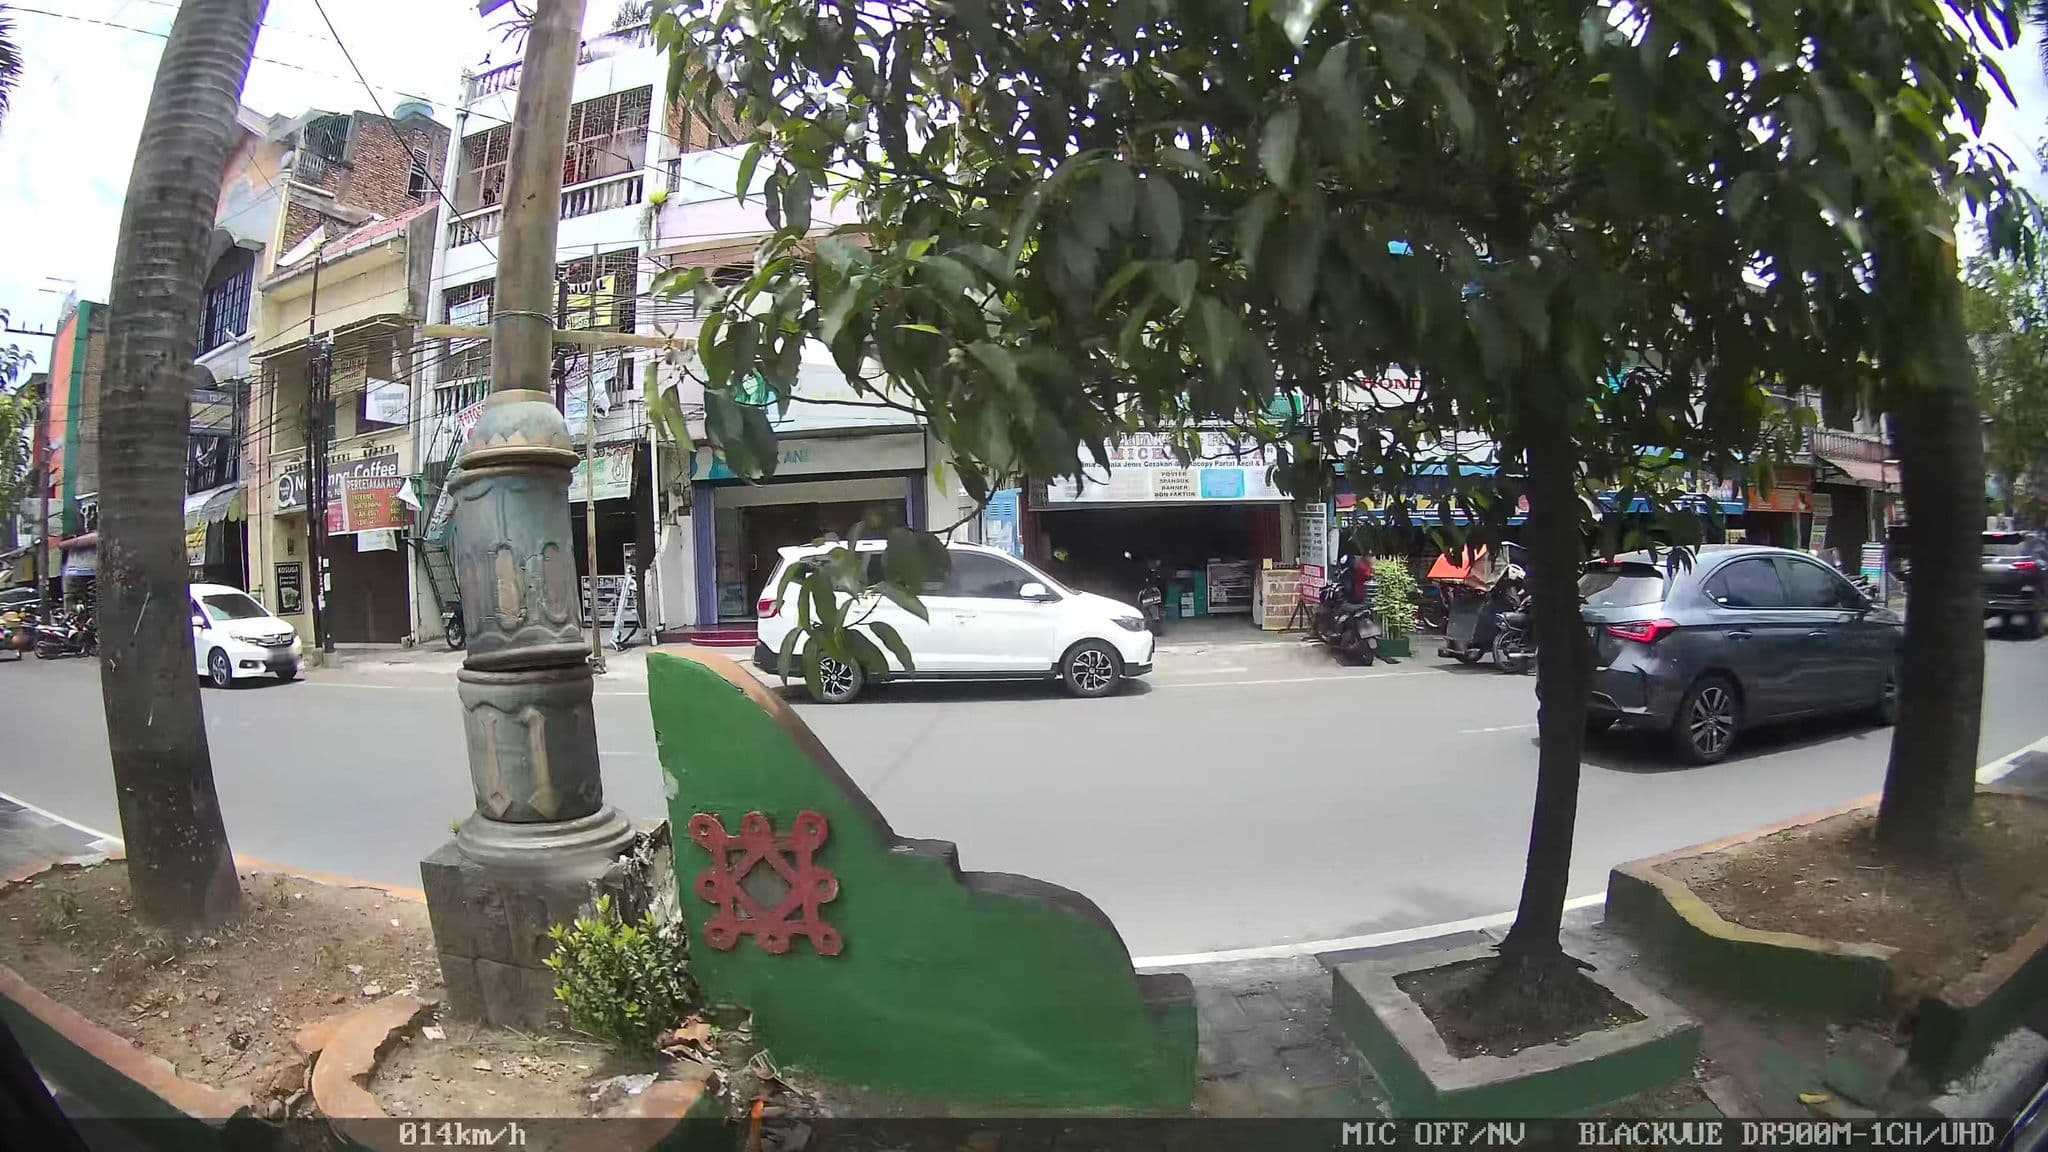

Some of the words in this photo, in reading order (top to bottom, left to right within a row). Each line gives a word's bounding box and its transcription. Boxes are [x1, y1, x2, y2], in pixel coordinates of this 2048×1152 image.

[1361, 377, 1421, 390] HOND
[354, 460, 396, 478] Coffee
[346, 478, 386, 491] PERCETAKAN
